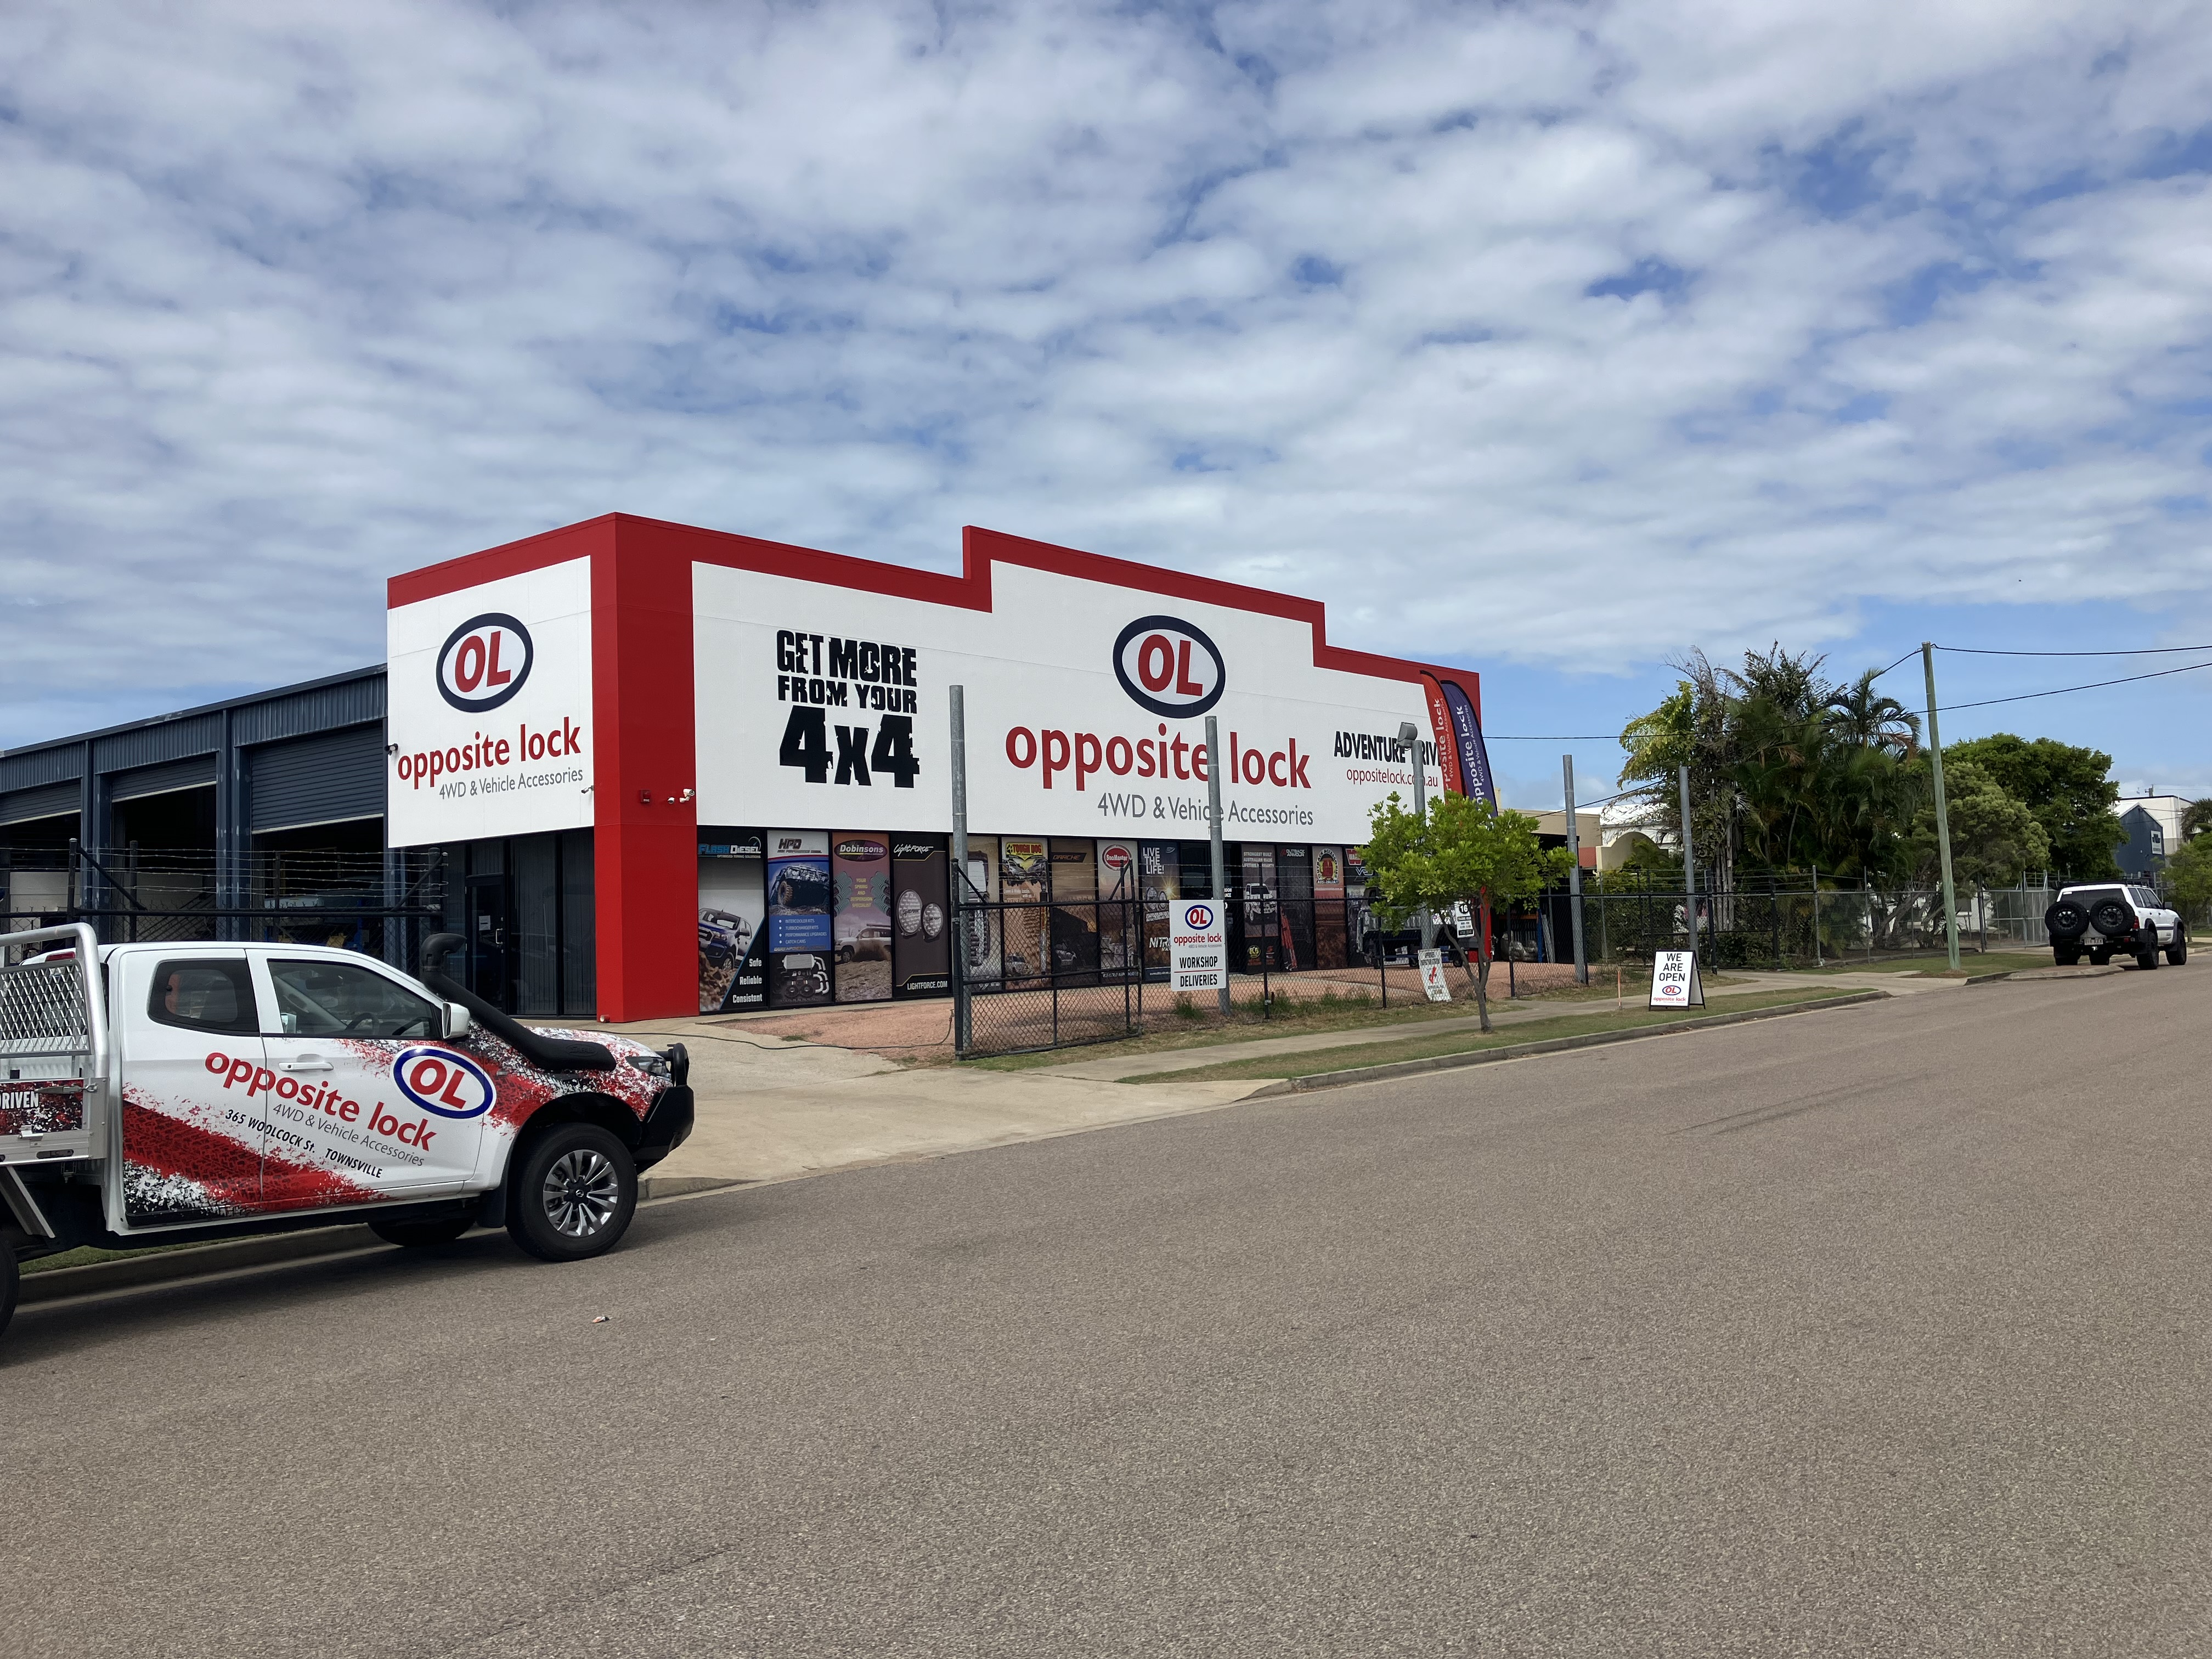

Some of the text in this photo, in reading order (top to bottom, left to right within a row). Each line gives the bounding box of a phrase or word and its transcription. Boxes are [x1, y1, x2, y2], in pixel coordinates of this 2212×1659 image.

[455, 630, 511, 692] OL
[777, 630, 917, 687] GET MORE
[1138, 634, 1203, 696] OL
[778, 675, 917, 714] FROM YOUR
[1434, 698, 1444, 731] lock
[1464, 705, 1475, 738] Accessories
[398, 716, 581, 789] opposite lock
[780, 705, 919, 788] 4x4
[1334, 731, 1406, 763] ADVENTURE
[1457, 706, 1485, 805] opposite lock
[1006, 723, 1311, 791] opposite lock
[439, 767, 583, 799] 4WD & Vehicle Accessories
[1347, 768, 1438, 787] oppositelock.c.au
[1098, 793, 1313, 825] 4WD & Vehice Accessories
[839, 844, 884, 854] Dobinsons
[1013, 844, 1042, 854] TOUGH DOG
[1143, 847, 1160, 856] LIVE
[1144, 856, 1160, 865] THE
[1146, 865, 1164, 874] LIFE!
[1190, 909, 1207, 924] OL
[1174, 933, 1222, 946] opposite lock
[749, 958, 762, 967] Safe
[1180, 956, 1218, 968] WORKSHOP
[1667, 953, 1682, 962] WE
[1659, 973, 1685, 981] OPEN
[1663, 963, 1683, 972] ARE
[740, 975, 762, 985] Reliable
[907, 980, 947, 990] LIGHTFORCE.COM
[1180, 974, 1217, 987] DELIVERIES
[732, 993, 763, 1003] Consistent
[409, 1058, 471, 1109] OL
[0, 1091, 39, 1109] RIVEN
[205, 1052, 437, 1152] opposite lock
[225, 1109, 383, 1178] 365 WOOLCOCK St. TOWNSVILLE
[273, 1104, 425, 1166] 4WD & Vehicle Accessories
